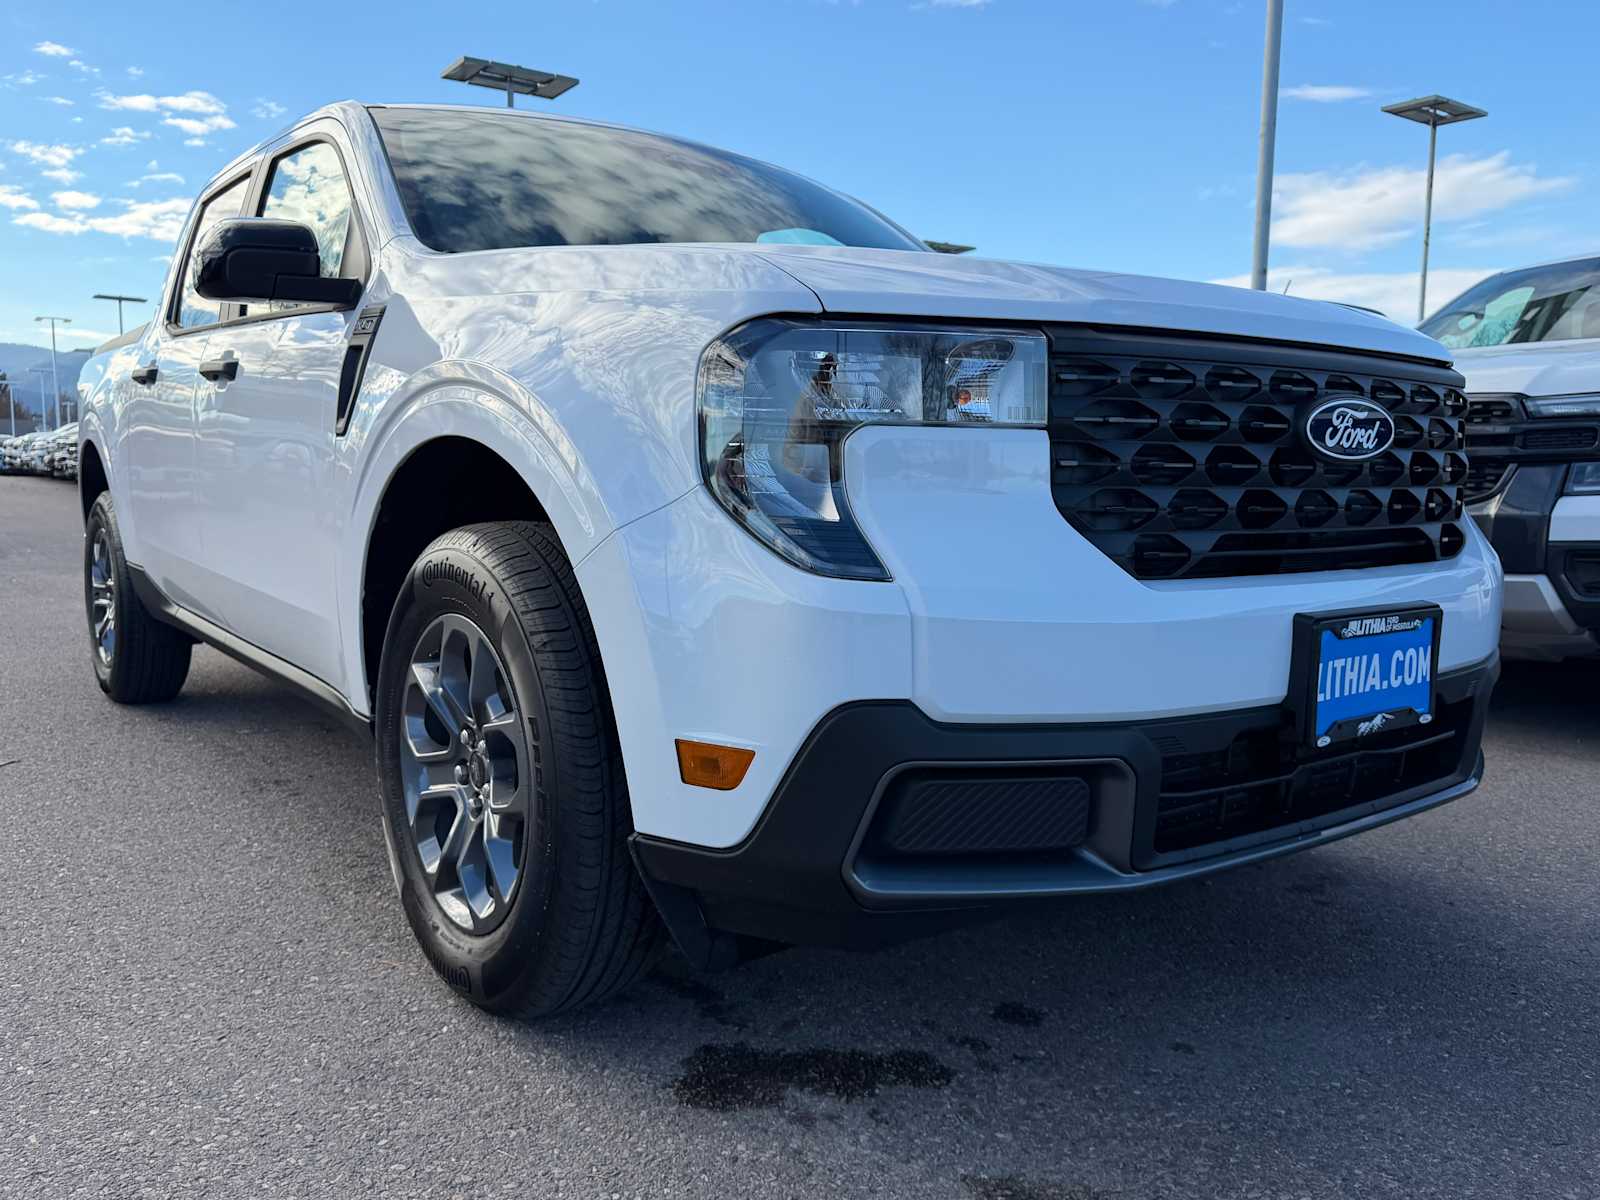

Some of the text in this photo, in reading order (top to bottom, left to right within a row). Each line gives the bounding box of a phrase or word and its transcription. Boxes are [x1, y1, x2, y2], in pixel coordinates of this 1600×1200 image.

[1325, 407, 1380, 449] Ford
[422, 557, 487, 601] Continental
[1356, 617, 1386, 636] LITHIA
[1317, 645, 1431, 702] LITHIA.COM
